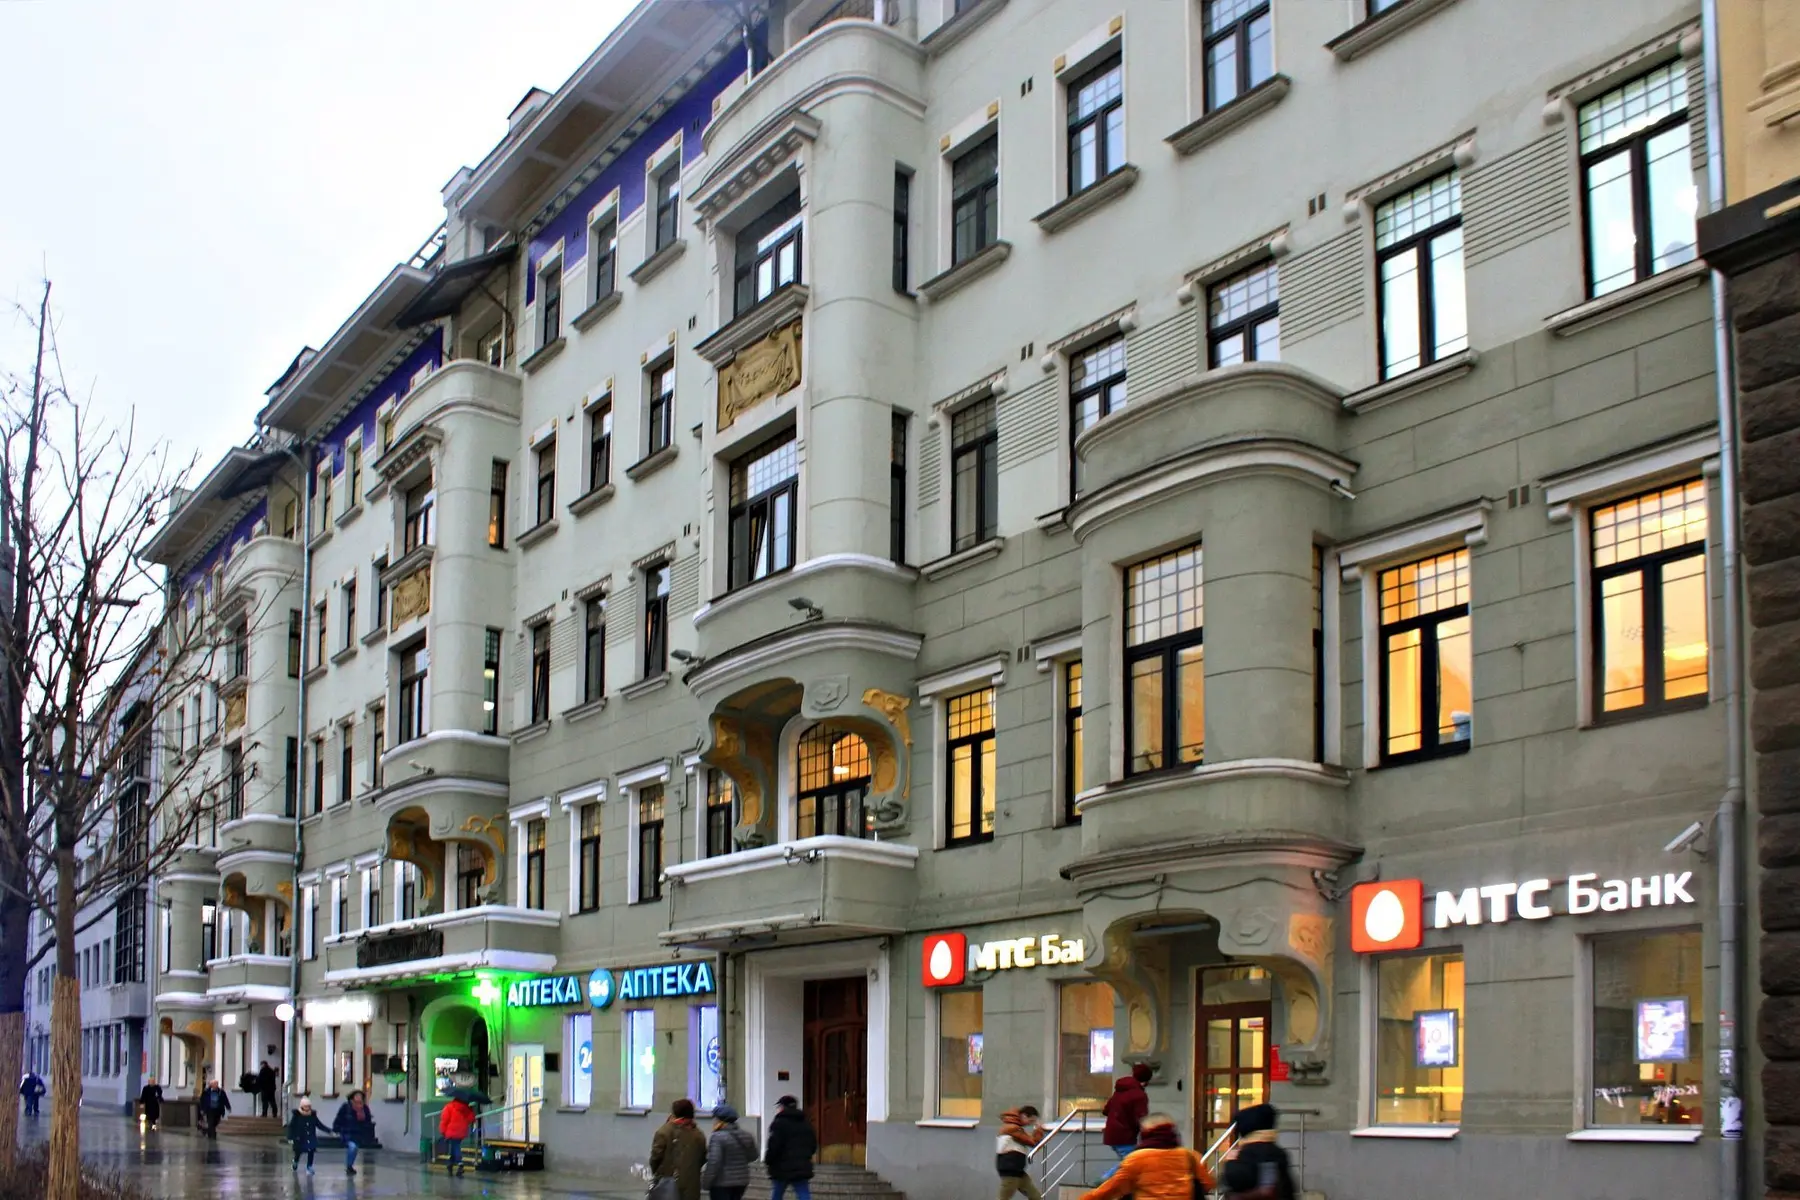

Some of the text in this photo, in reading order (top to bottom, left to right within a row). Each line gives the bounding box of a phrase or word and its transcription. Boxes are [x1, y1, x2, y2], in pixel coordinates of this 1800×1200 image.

[1434, 870, 1696, 929] МТС Банк
[968, 937, 1036, 972] МТС
[507, 976, 581, 1007] АПТЕКА
[619, 962, 713, 1000] АПТЕКА
